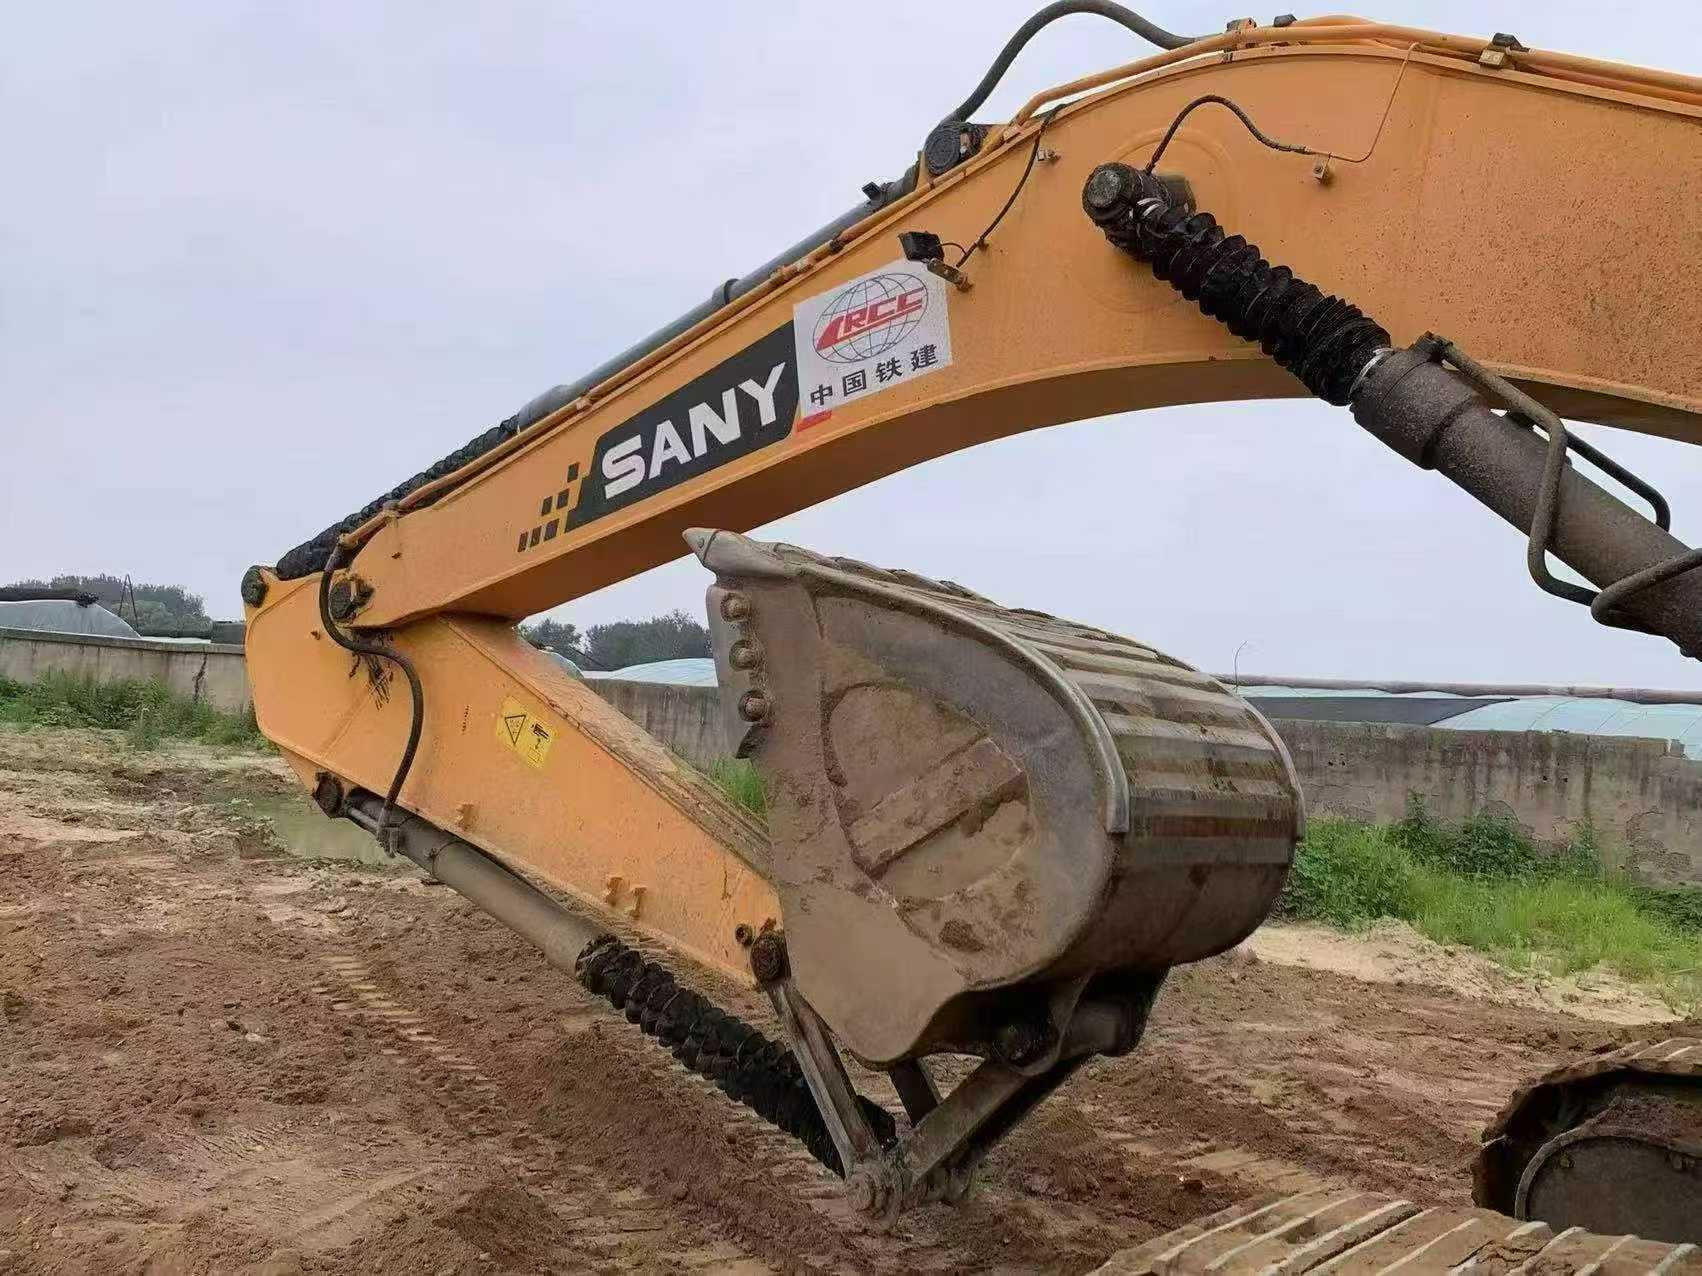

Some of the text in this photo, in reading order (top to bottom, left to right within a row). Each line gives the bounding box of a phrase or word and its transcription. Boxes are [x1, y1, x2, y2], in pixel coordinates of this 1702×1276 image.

[810, 344, 938, 406] 中国铁建
[602, 361, 785, 500] SANY
